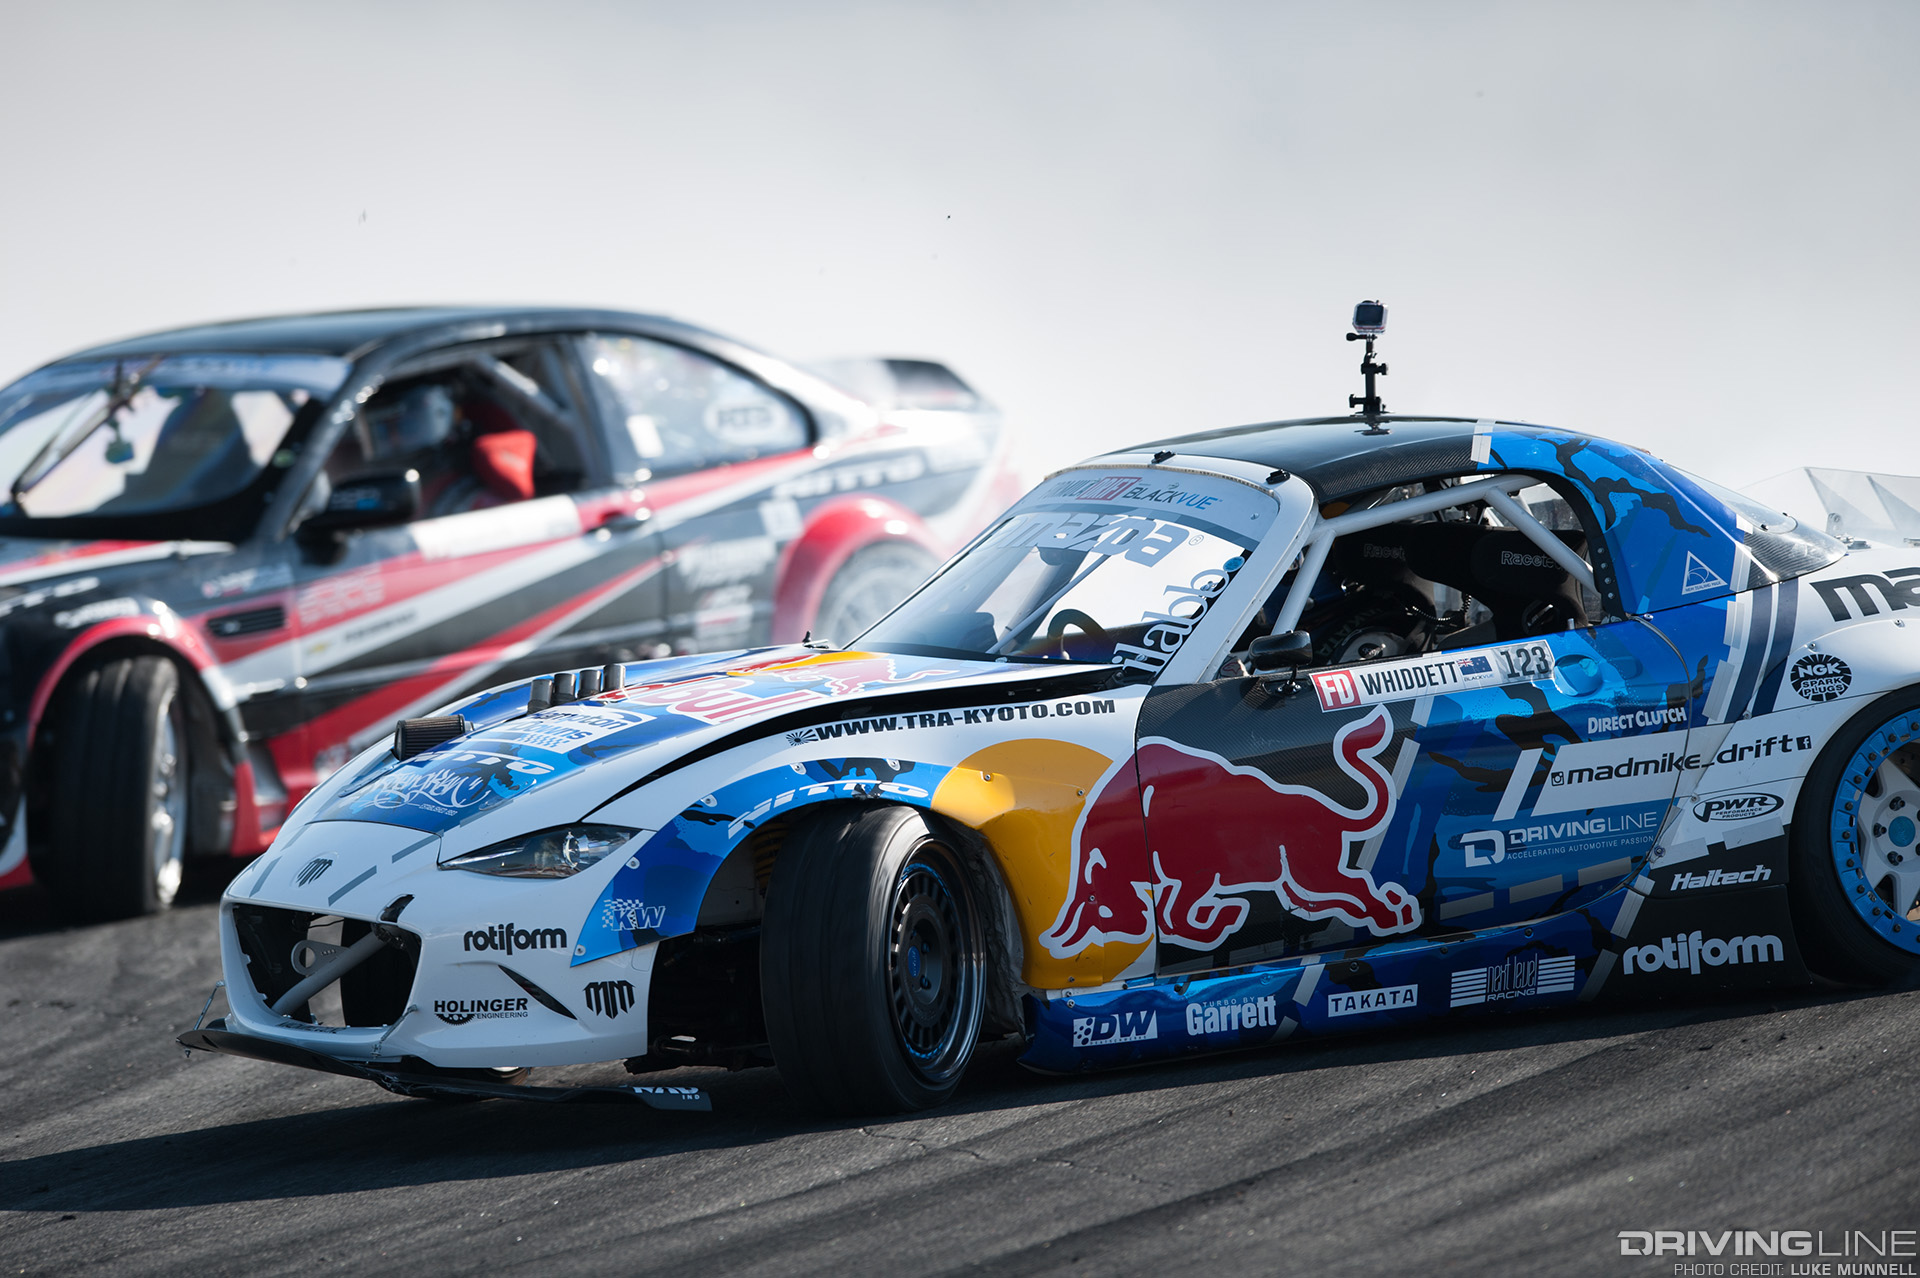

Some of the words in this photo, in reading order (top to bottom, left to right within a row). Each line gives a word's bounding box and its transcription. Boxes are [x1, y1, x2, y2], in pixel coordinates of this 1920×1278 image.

[1122, 487, 1217, 510] BLACKVUE
[1319, 672, 1356, 707] FD
[1360, 662, 1459, 696] WHIDDETT
[1501, 646, 1550, 679] 123
[1797, 662, 1841, 678] NGK
[1802, 676, 1843, 688] SPARK
[1802, 684, 1844, 696] PLUGS
[816, 700, 1116, 740] WWW.TRA-KYOTO.COM
[1588, 714, 1634, 734] DIRECT
[1636, 707, 1687, 727] CLUTCH
[1567, 734, 1794, 785] madmike_drift
[1702, 796, 1774, 822] PWR
[1507, 847, 1566, 860] ACCELERATING
[1568, 840, 1618, 853] AUTOMOTIVE
[1620, 834, 1655, 846] PASSION
[1670, 864, 1772, 891] Haltech
[612, 906, 665, 932] KW
[464, 923, 567, 955] rotiform
[1622, 930, 1784, 975] rotiform
[1487, 957, 1511, 993] next
[1512, 953, 1538, 989] level
[434, 998, 528, 1013] HOLINGER
[1203, 999, 1236, 1007] TURBO
[1243, 996, 1255, 1004] BY
[1331, 989, 1415, 1012] TAKATA
[1487, 987, 1536, 1002] RACING
[477, 1011, 529, 1019] ENGINEERING
[1186, 995, 1277, 1036] Garrett
